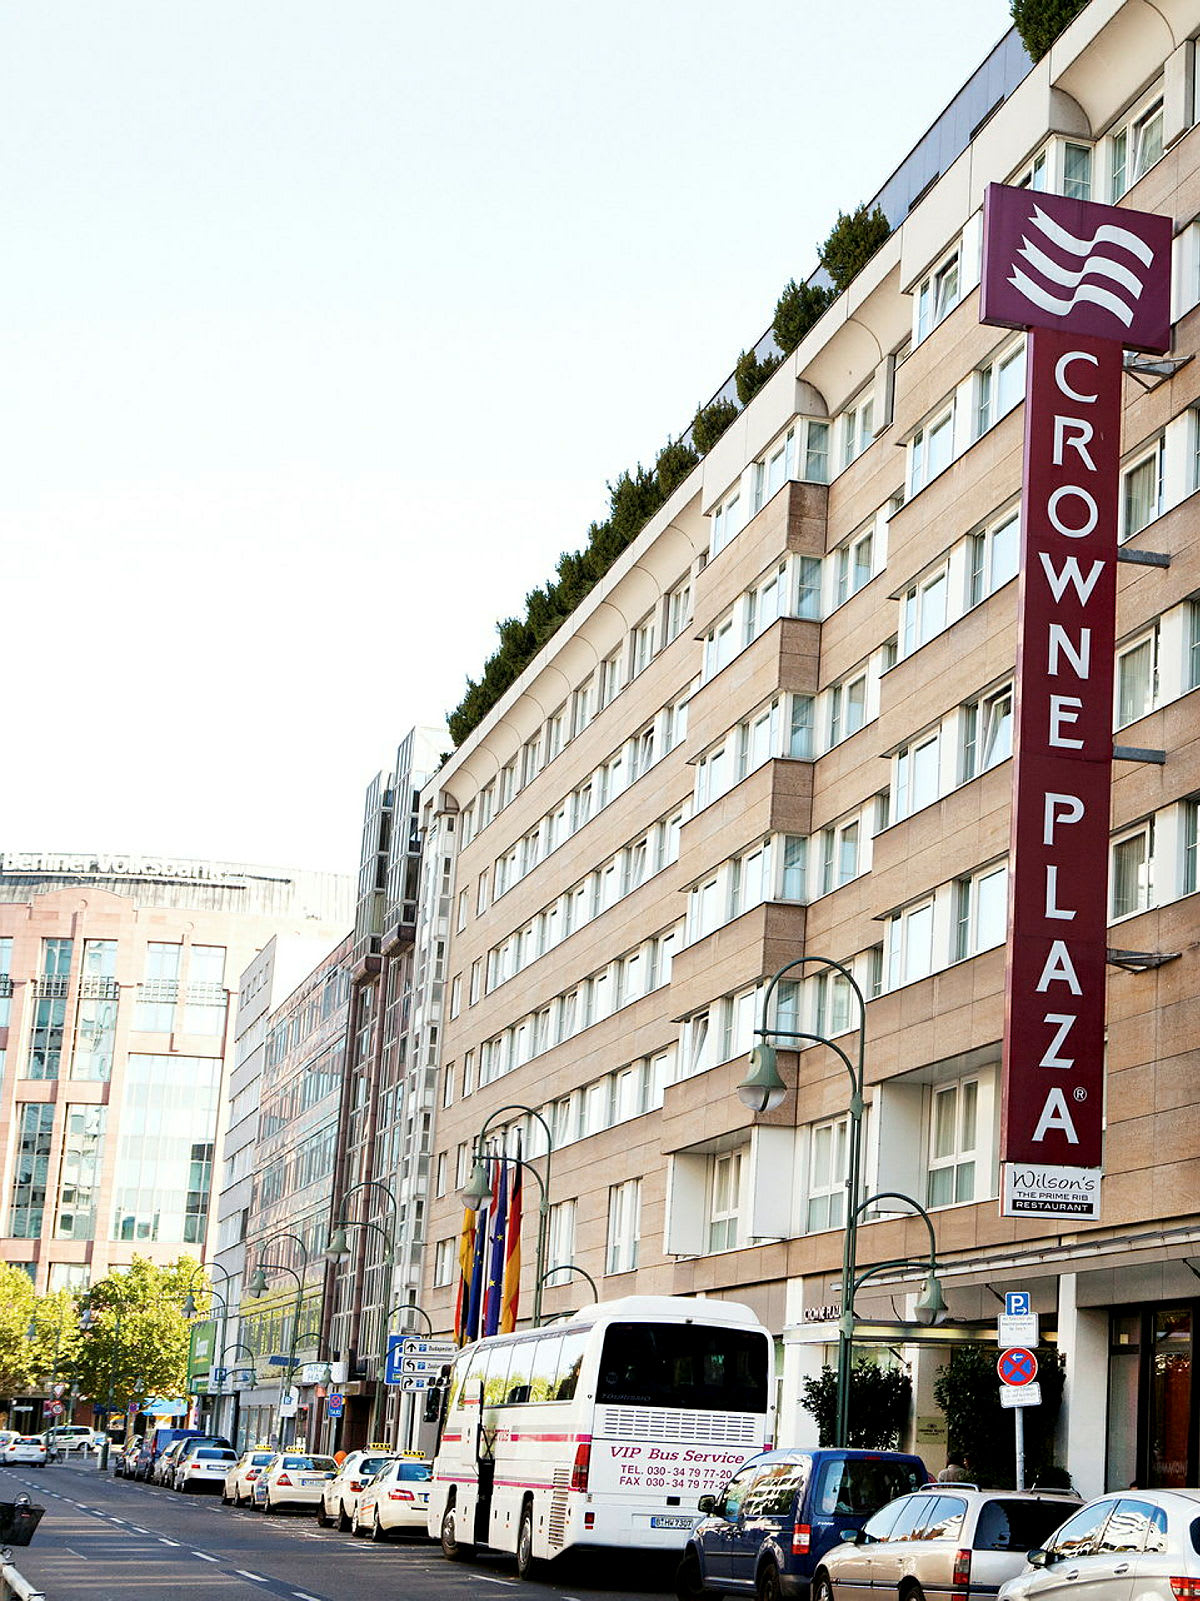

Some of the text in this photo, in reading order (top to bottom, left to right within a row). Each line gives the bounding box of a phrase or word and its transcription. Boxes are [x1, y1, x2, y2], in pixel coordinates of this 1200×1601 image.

[1039, 350, 1106, 750] CROWNE
[1013, 1170, 1095, 1191] Wilson's
[1017, 1191, 1037, 1199] THE
[1039, 1192, 1070, 1200] PRIME
[1016, 1201, 1089, 1211] RESTAURANT
[1011, 1295, 1024, 1313] P
[611, 1446, 745, 1464] VIP Bus Service
[621, 1465, 644, 1475] TEL.
[688, 1468, 701, 1478] 79
[704, 1469, 733, 1479] 77-20
[619, 1476, 640, 1486] FAX
[687, 1479, 700, 1489] 79
